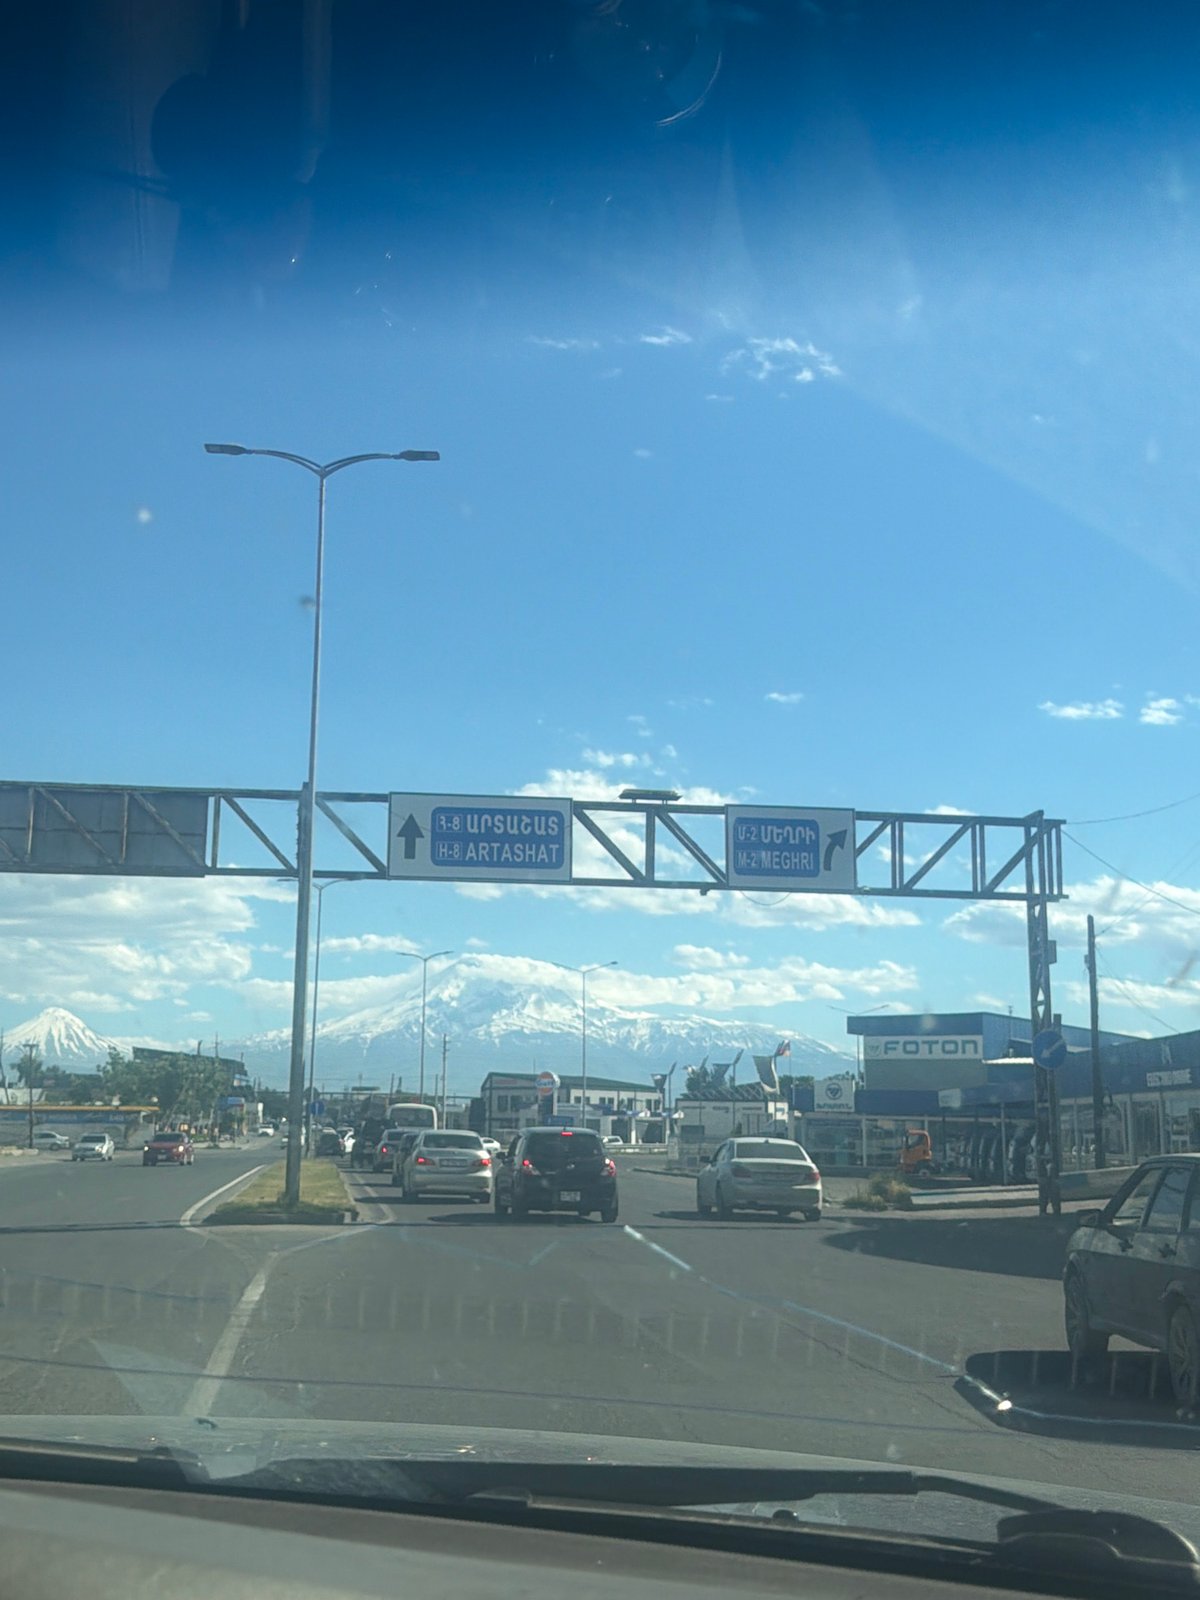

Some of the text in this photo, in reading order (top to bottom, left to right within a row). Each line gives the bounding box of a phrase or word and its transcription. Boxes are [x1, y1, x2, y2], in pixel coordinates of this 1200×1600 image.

[466, 813, 559, 836] ԱՐՏԱՇԱՏ
[760, 824, 816, 845] ՄԵՂՐԻ
[439, 842, 560, 863] H-8 ARTASHAT
[737, 850, 814, 870] M-2 MEGHRI
